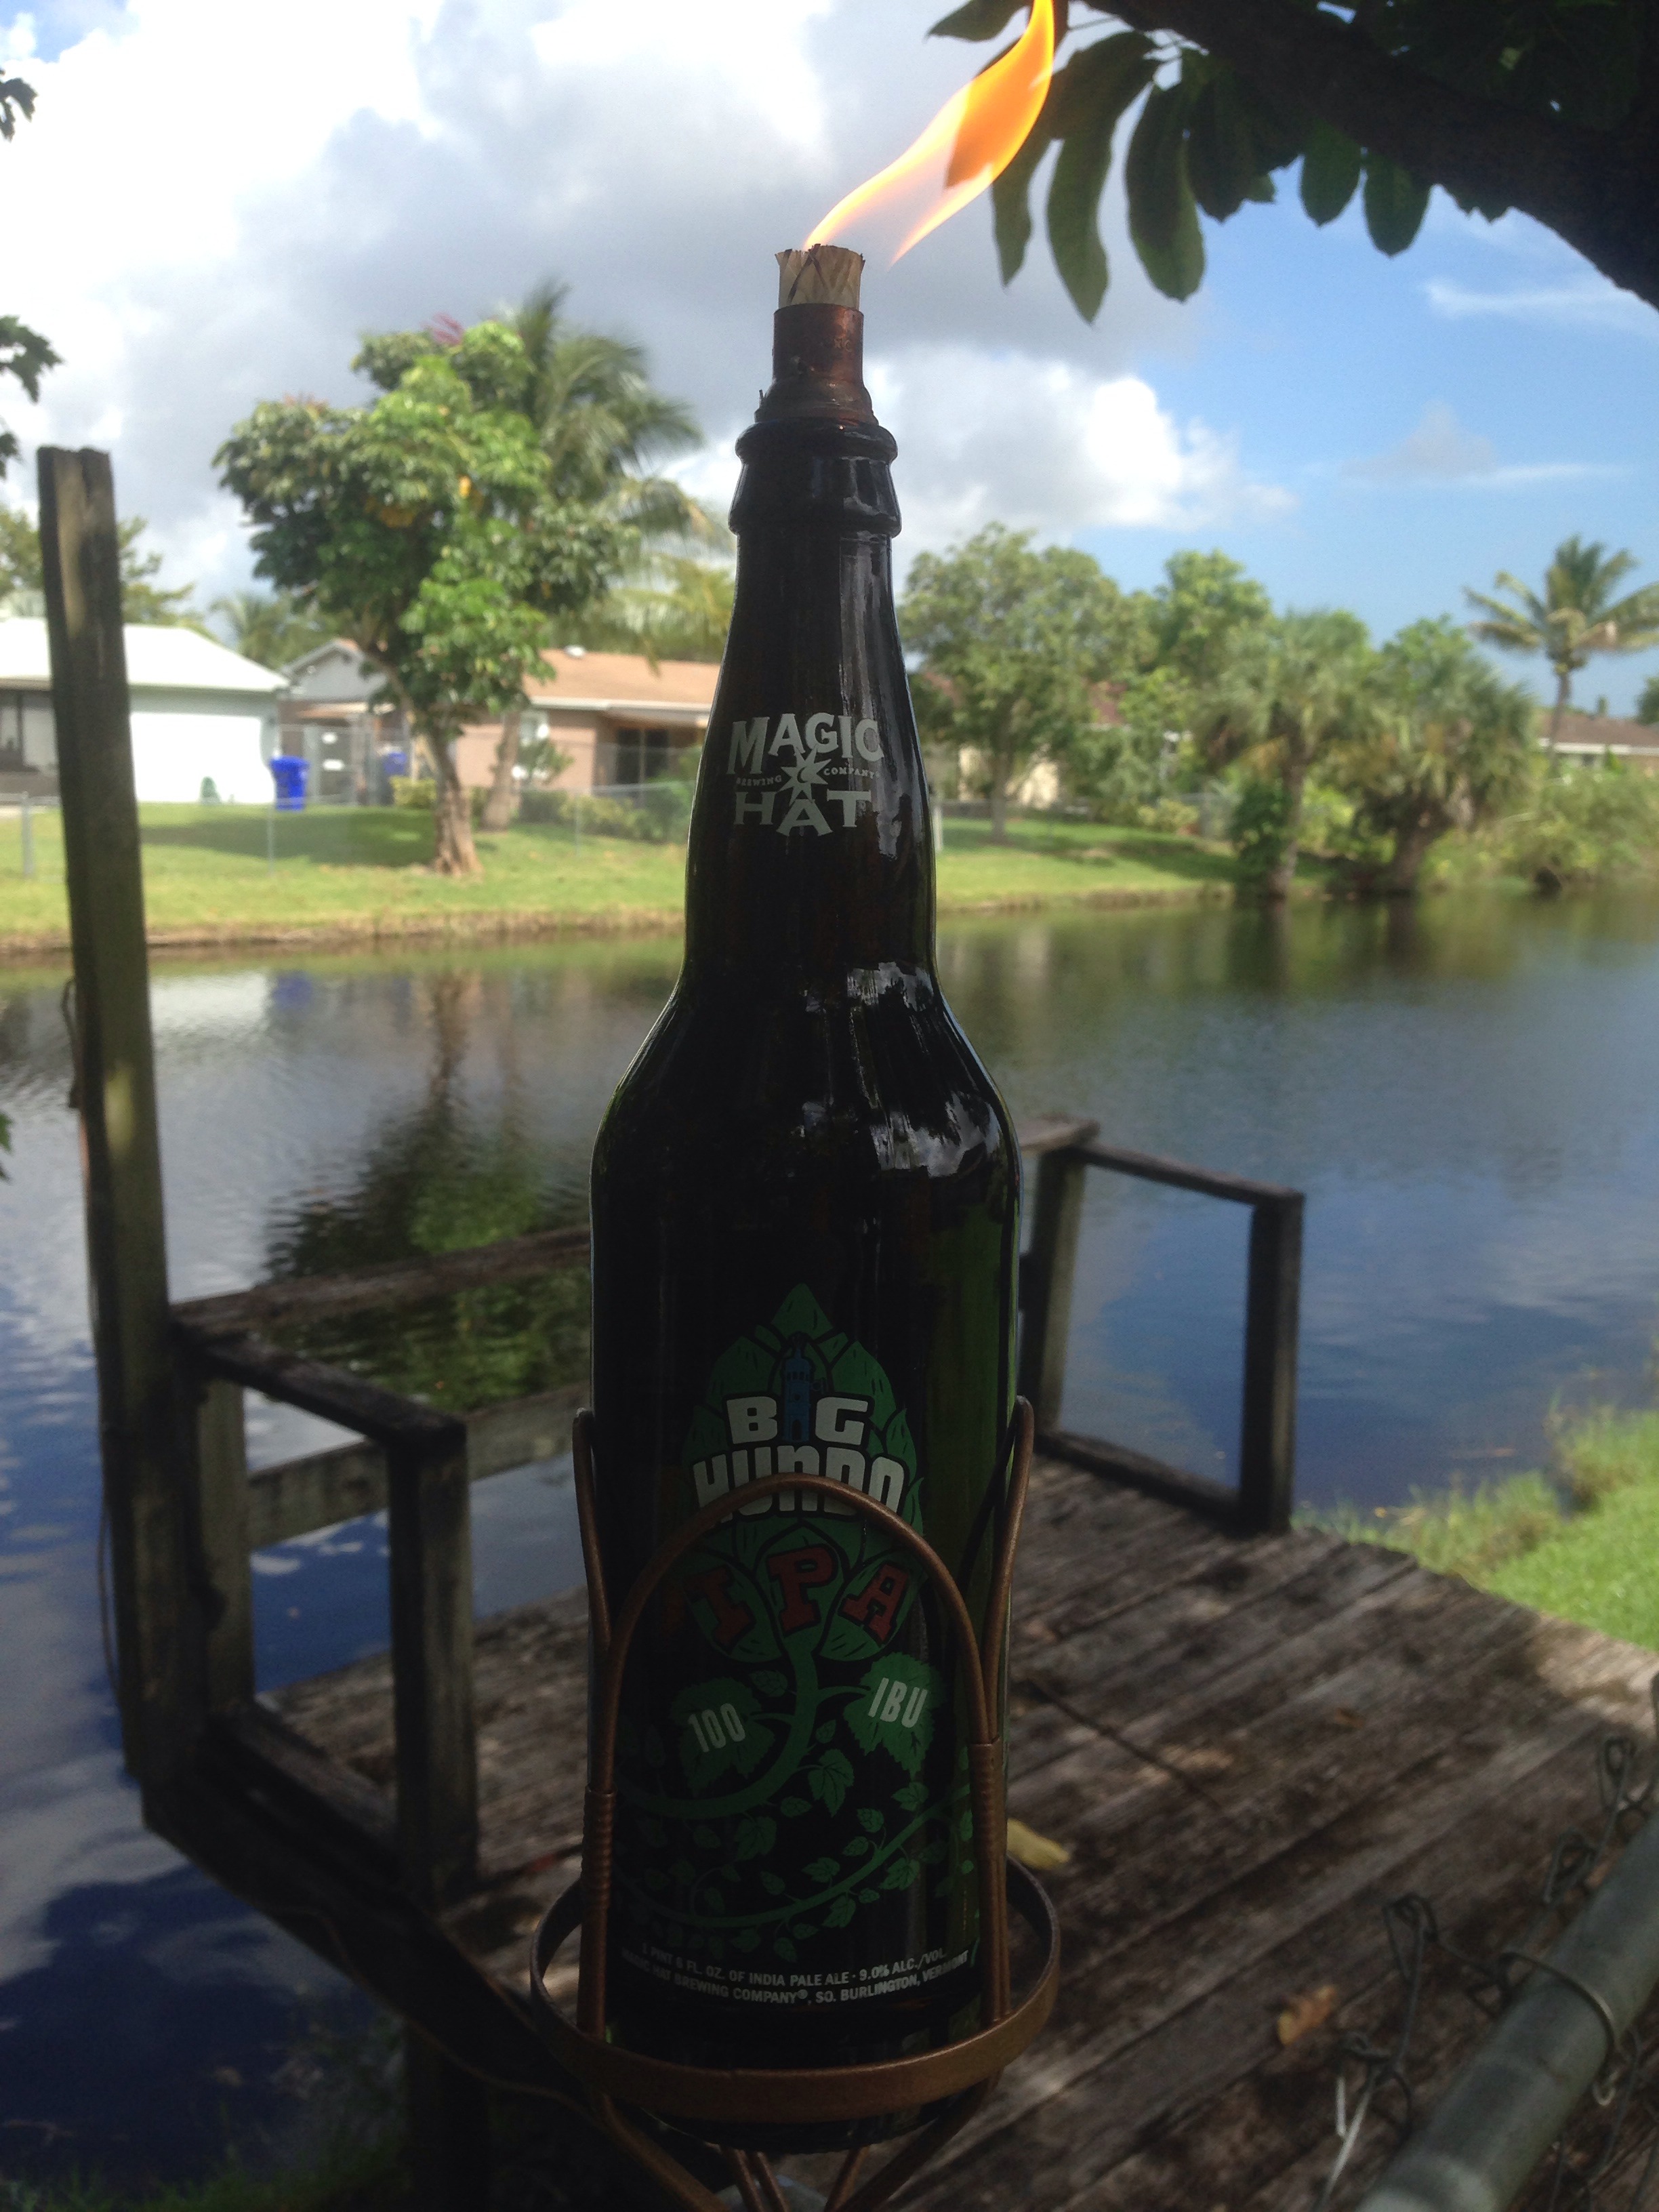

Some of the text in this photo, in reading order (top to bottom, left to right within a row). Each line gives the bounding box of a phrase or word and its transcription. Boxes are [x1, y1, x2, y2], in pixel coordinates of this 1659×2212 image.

[726, 712, 885, 775] MAGIC
[735, 775, 782, 786] BREWING
[733, 789, 872, 837] HAT
[686, 1544, 909, 1648] IPA
[688, 1677, 928, 1753] 100 IBU
[650, 1946, 674, 1965] PINT
[729, 1969, 745, 1982] OF
[749, 1972, 785, 1987] INDIA
[790, 1974, 822, 1987] PALE
[825, 1971, 850, 1986] ALE
[859, 1964, 890, 1982] 9.0%
[674, 1973, 729, 1999] BREWING
[815, 1990, 837, 2004] SO.
[840, 1973, 921, 2002] BURLINGTON,
[922, 1949, 969, 1983] VERMONT
